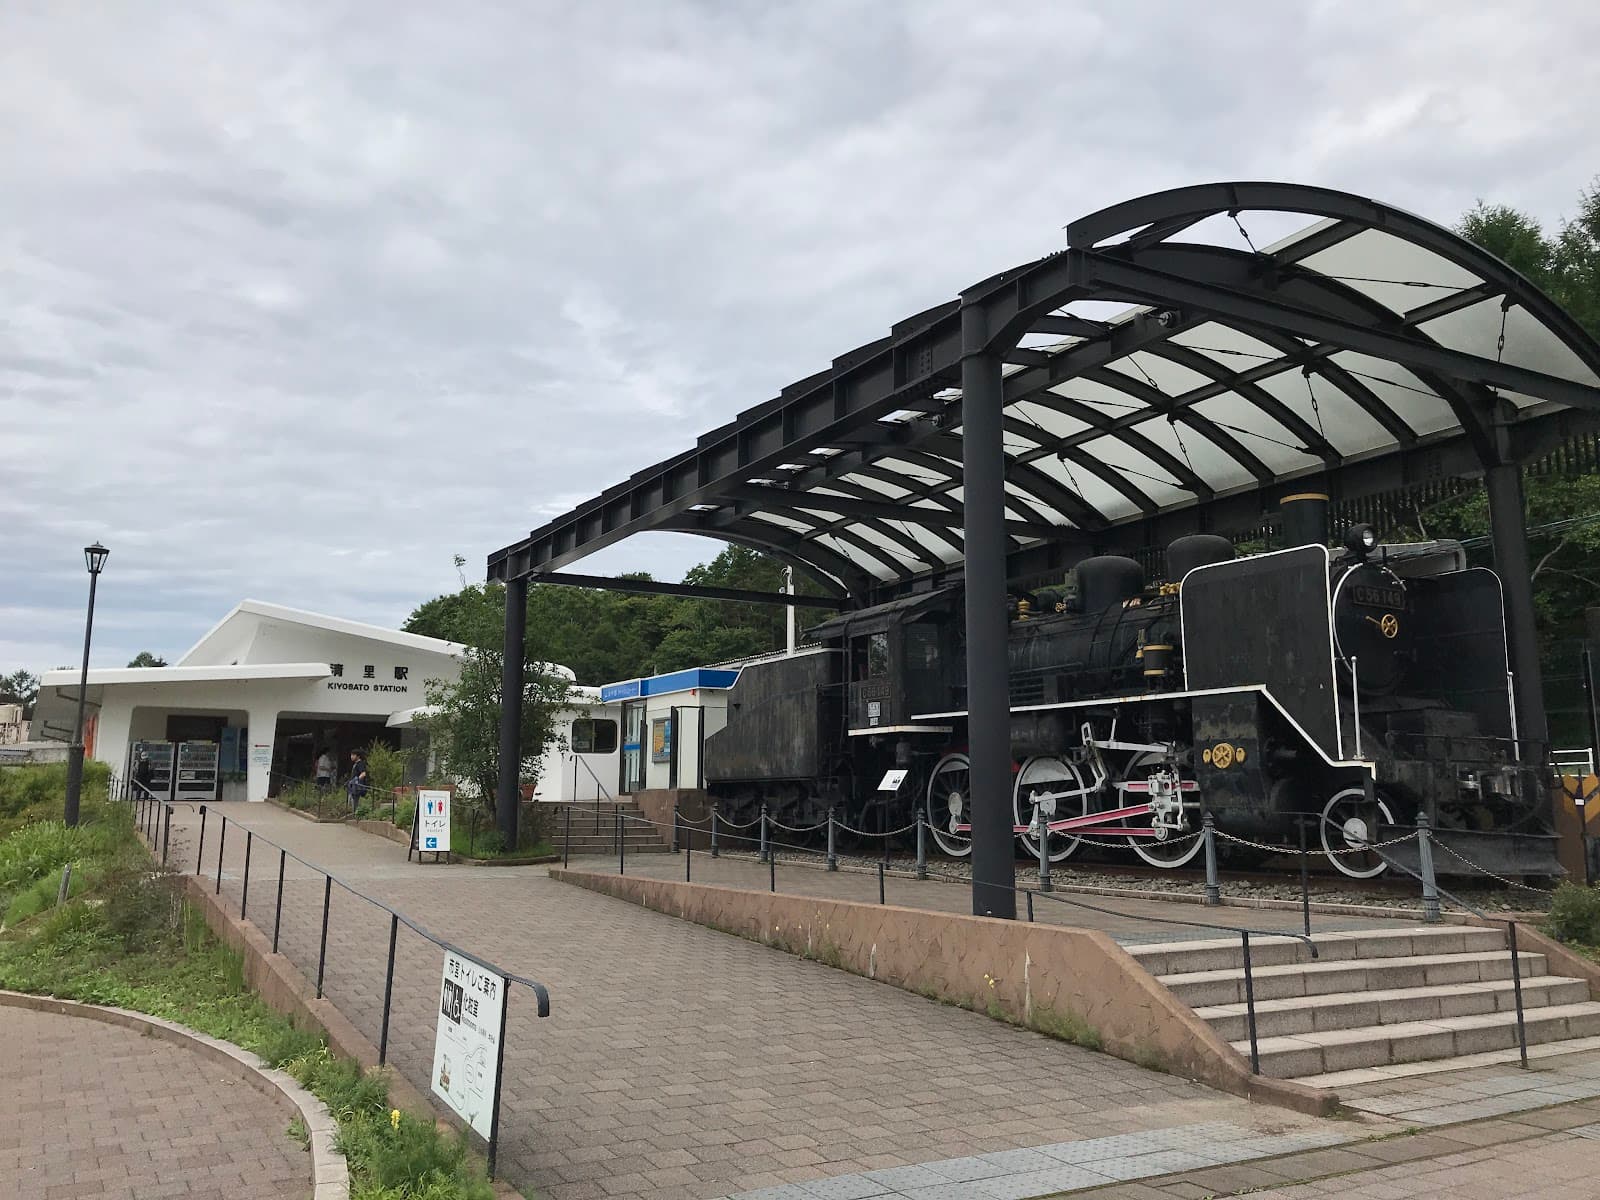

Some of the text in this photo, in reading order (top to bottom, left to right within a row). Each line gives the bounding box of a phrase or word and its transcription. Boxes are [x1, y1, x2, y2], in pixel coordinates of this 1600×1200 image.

[330, 663, 408, 680] 清里駅
[327, 682, 407, 693] KIYOSATO STATION
[425, 820, 446, 828] トイレ
